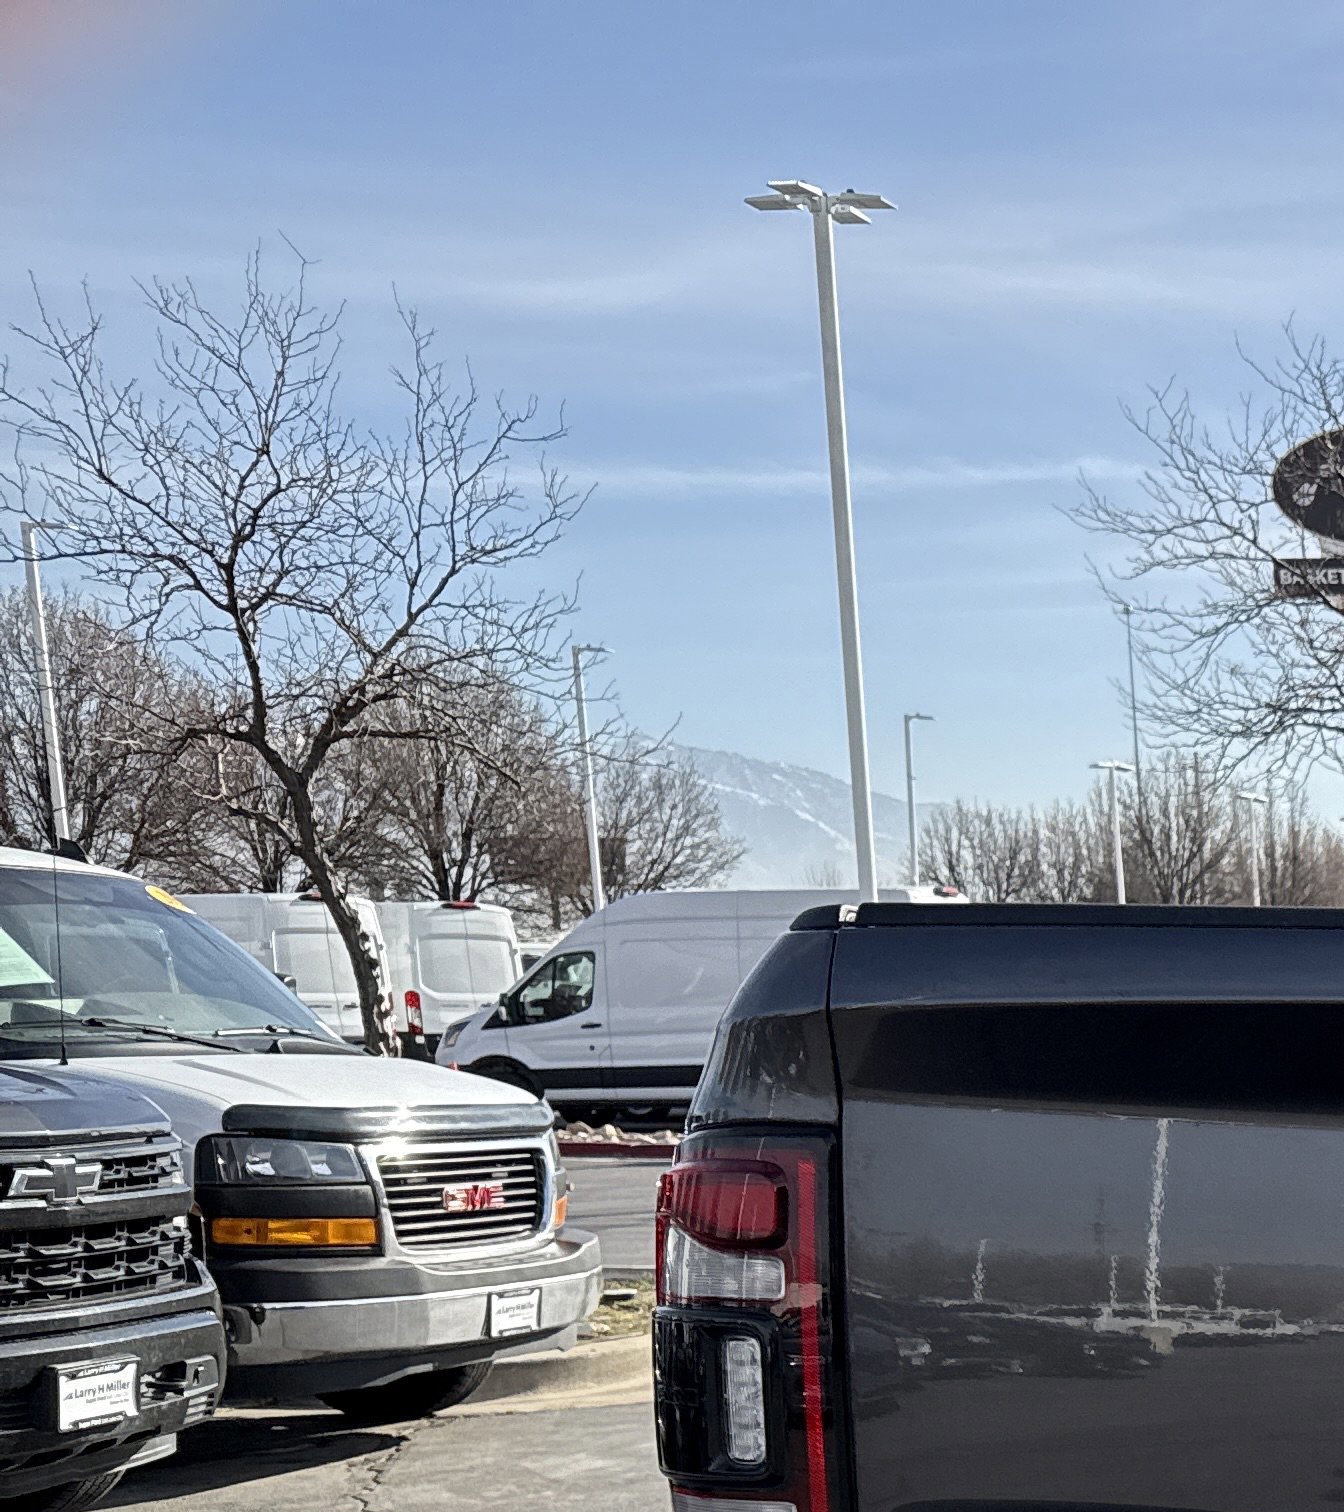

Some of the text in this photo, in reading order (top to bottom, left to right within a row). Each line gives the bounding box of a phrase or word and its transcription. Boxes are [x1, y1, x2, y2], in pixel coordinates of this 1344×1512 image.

[75, 1387, 96, 1399] Larry
[98, 1384, 104, 1394] H
[106, 1379, 130, 1393] Miller
